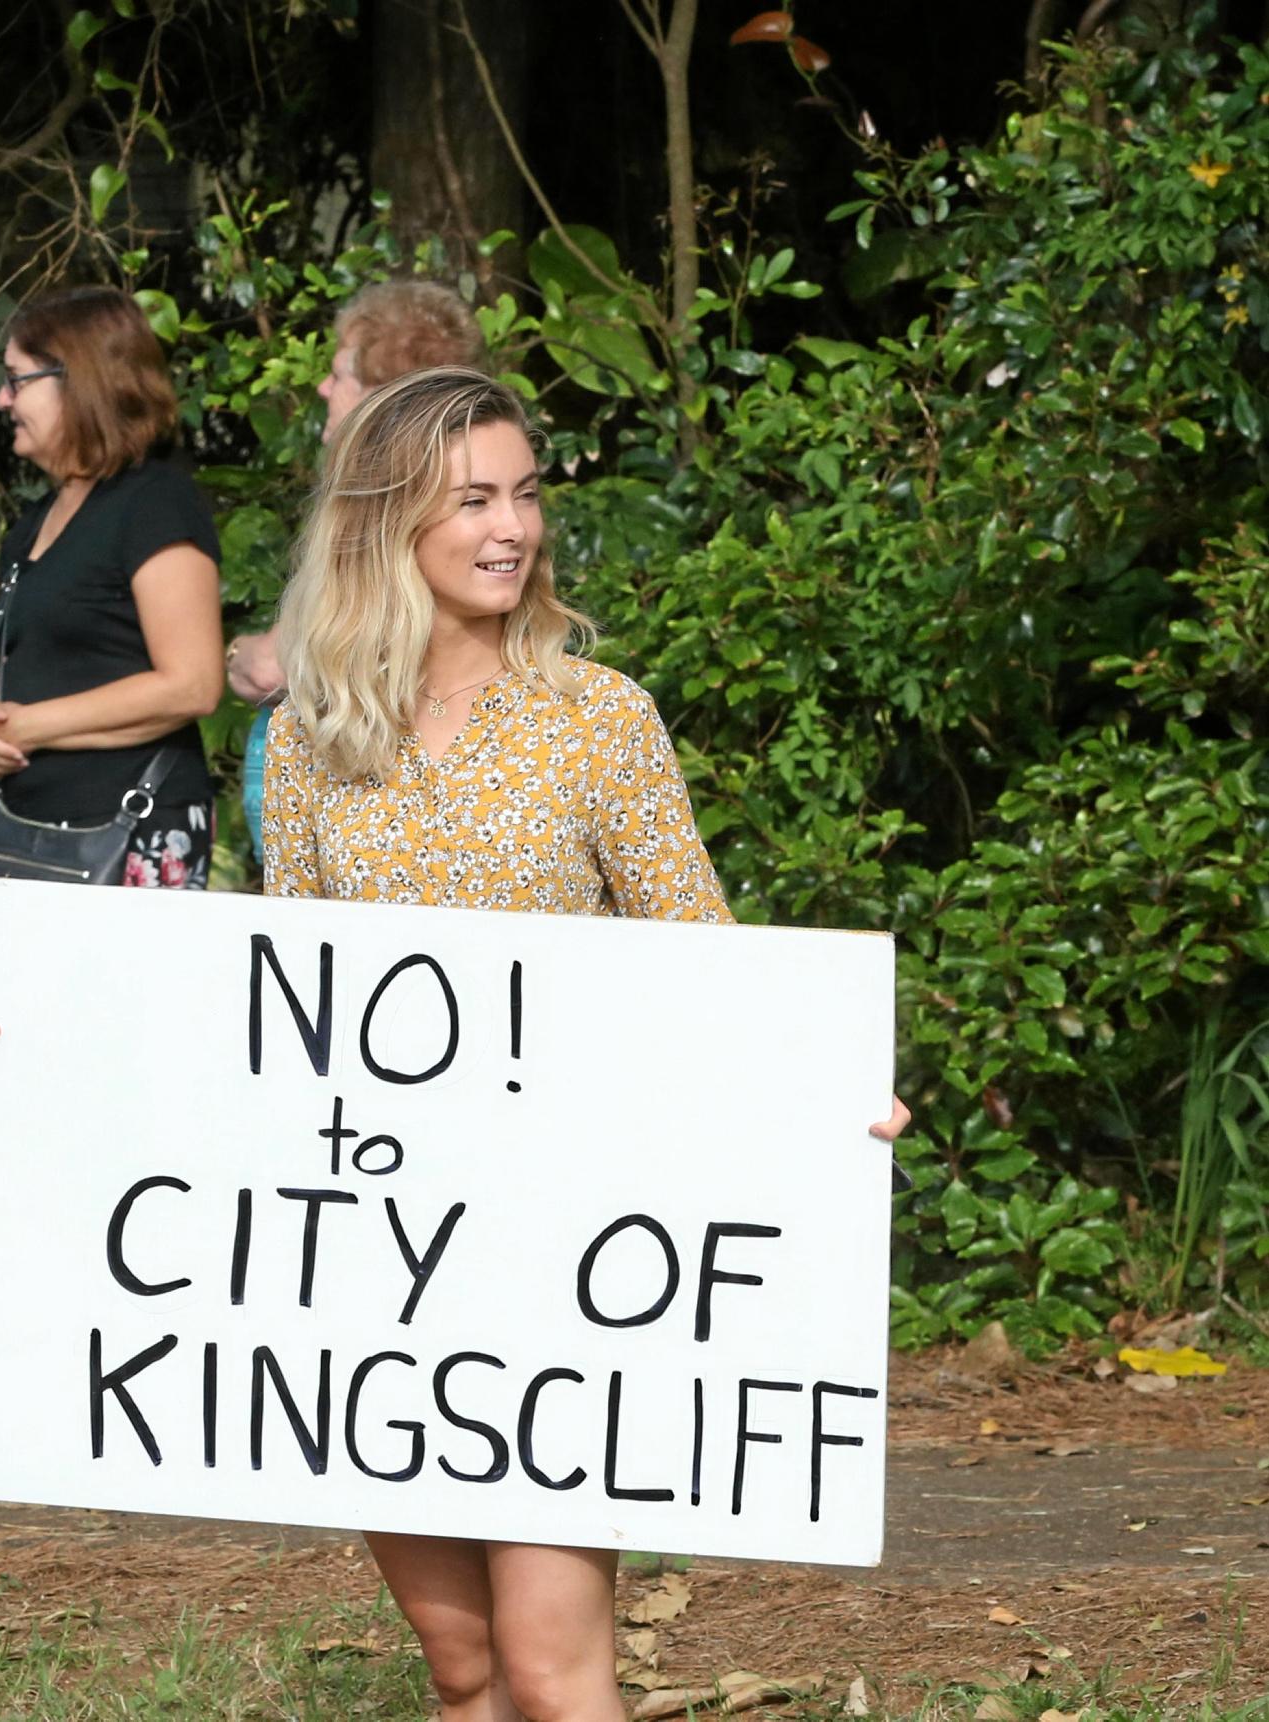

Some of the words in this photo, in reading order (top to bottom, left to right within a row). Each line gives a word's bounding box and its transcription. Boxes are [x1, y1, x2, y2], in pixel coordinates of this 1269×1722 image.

[248, 933, 523, 1094] NO!
[318, 1095, 404, 1177] to
[105, 1175, 467, 1327] CITY
[576, 1212, 783, 1344] OF
[88, 1326, 880, 1523] KINGSCLIFF
